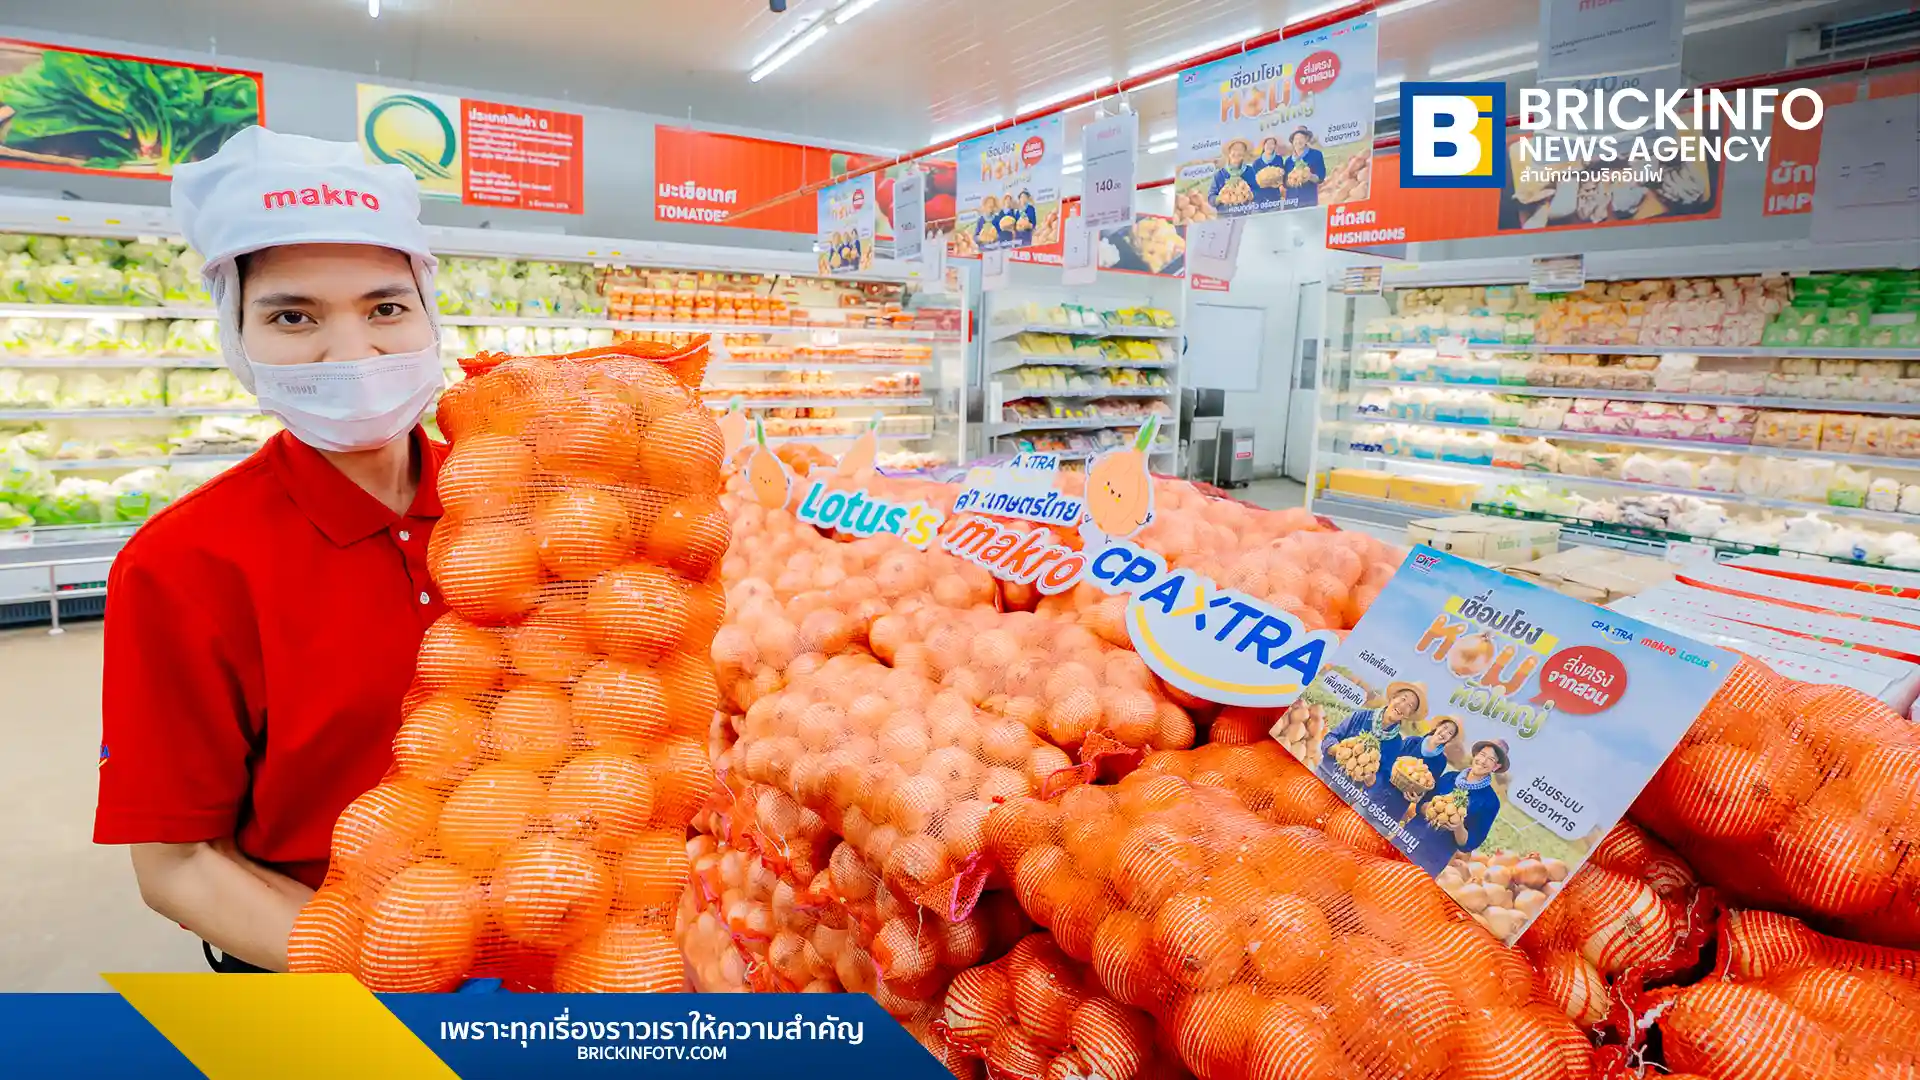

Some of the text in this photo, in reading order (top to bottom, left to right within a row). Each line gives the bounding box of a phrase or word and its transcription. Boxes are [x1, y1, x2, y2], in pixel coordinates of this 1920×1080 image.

[1230, 63, 1284, 89] เชื่อมโยง
[263, 184, 380, 212] makro
[658, 180, 738, 204] มะเขือเทศ
[1330, 206, 1376, 226] เห็ดสด
[1329, 227, 1406, 245] MUSHROOMS
[800, 482, 937, 546] Lotus's
[947, 518, 1085, 589] makro
[1458, 589, 1544, 646] เชื่อมโยง
[1639, 637, 1677, 657] makro
[1358, 650, 1397, 678] หัวใจแข็งแรง
[1562, 654, 1615, 688] ส่งตรง
[1323, 674, 1363, 705] เพิ่มภูมิคุ้มกัน
[1548, 670, 1609, 706] จากสวน
[1450, 680, 1555, 738] หัวใหญ่
[1516, 787, 1576, 832] ย่อยอาหาร
[1531, 775, 1584, 814] ช่วยระบบ
